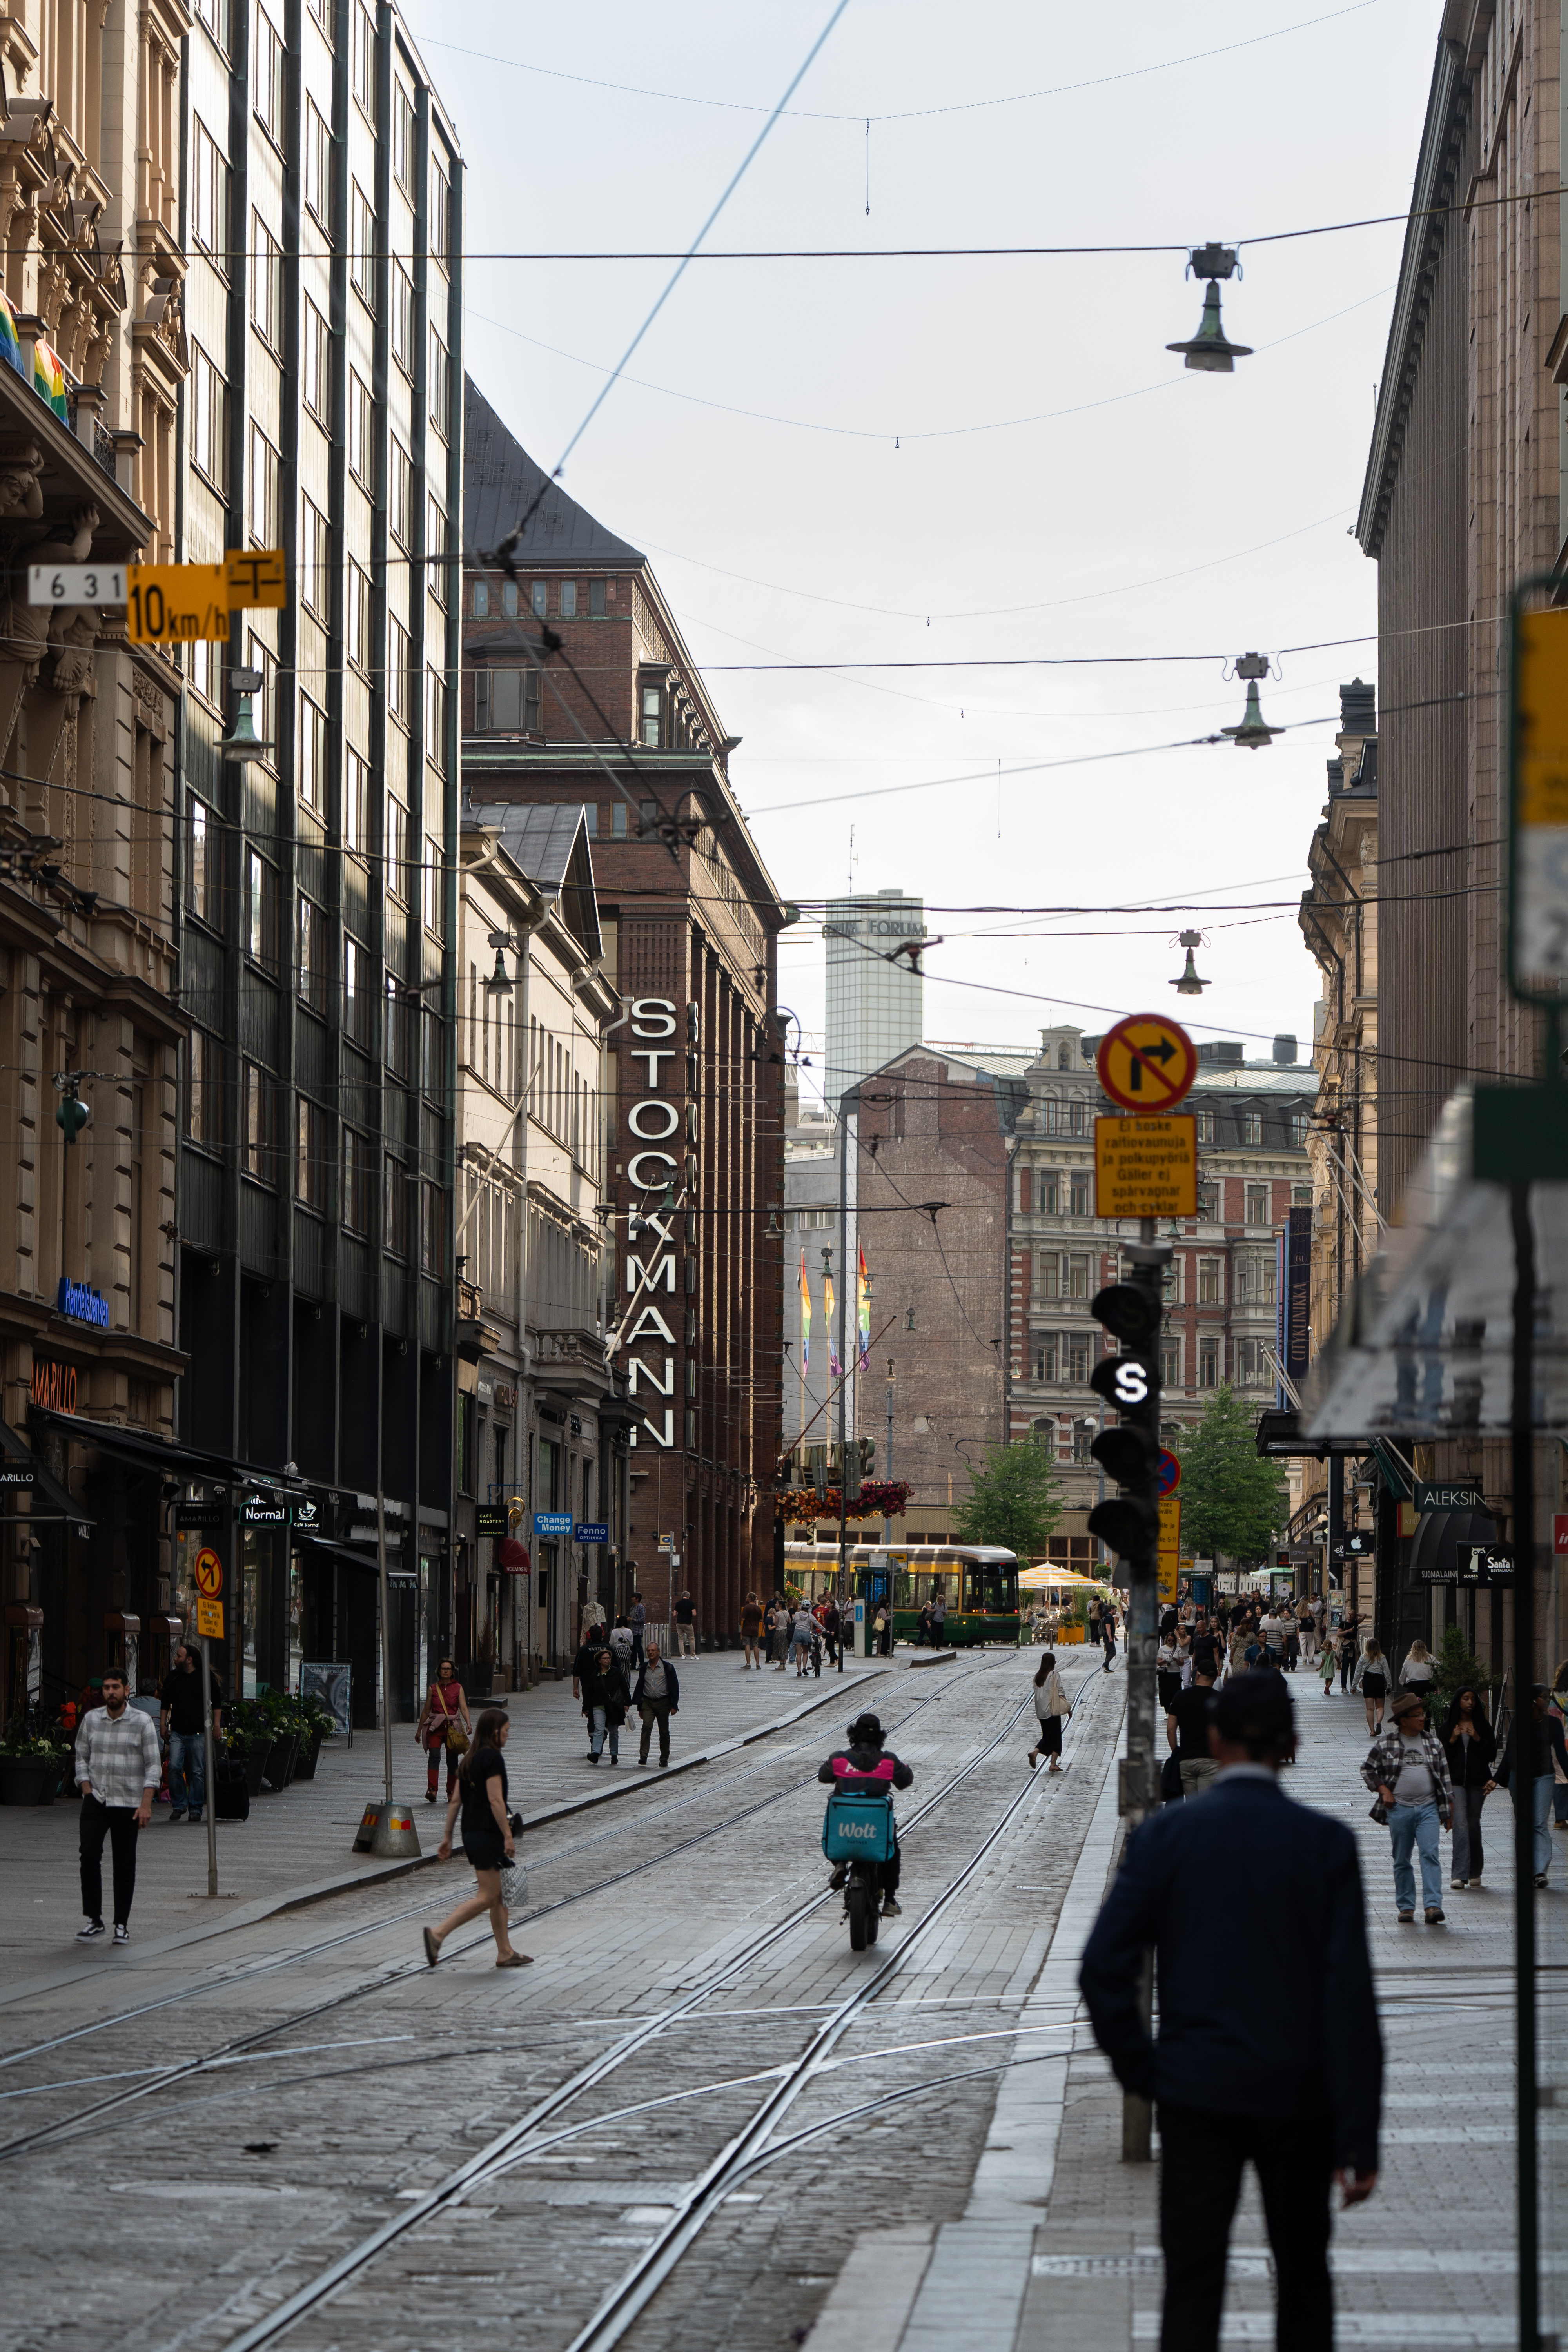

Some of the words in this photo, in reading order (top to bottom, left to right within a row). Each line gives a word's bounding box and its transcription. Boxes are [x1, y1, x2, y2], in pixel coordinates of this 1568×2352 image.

[869, 920, 925, 935] FORUM
[1120, 1119, 1130, 1132] Ei
[1136, 1120, 1171, 1132] koske
[1105, 1136, 1186, 1149] raitiovaunuja
[1103, 1153, 1114, 1167] ja
[1120, 1152, 1190, 1166] polkupyöriä
[1118, 1168, 1151, 1181] Gäller
[1158, 1169, 1169, 1181] ej
[1112, 1185, 1180, 1198] spårvagnar
[1114, 1201, 1136, 1212] och
[1141, 1200, 1178, 1215] cyklar
[626, 997, 679, 1449] STOCKMANN
[65, 1278, 109, 1328] Handelsbanken
[1292, 1283, 1307, 1361] CITYKLINIKKA
[246, 1507, 285, 1520] Normal
[537, 1516, 571, 1525] Change
[542, 1524, 571, 1533] Money
[578, 1526, 606, 1534] Fenno
[1487, 1557, 1511, 1568] Santa
[201, 1610, 220, 1619] polkyöriä
[839, 1822, 877, 1839] Wolt
